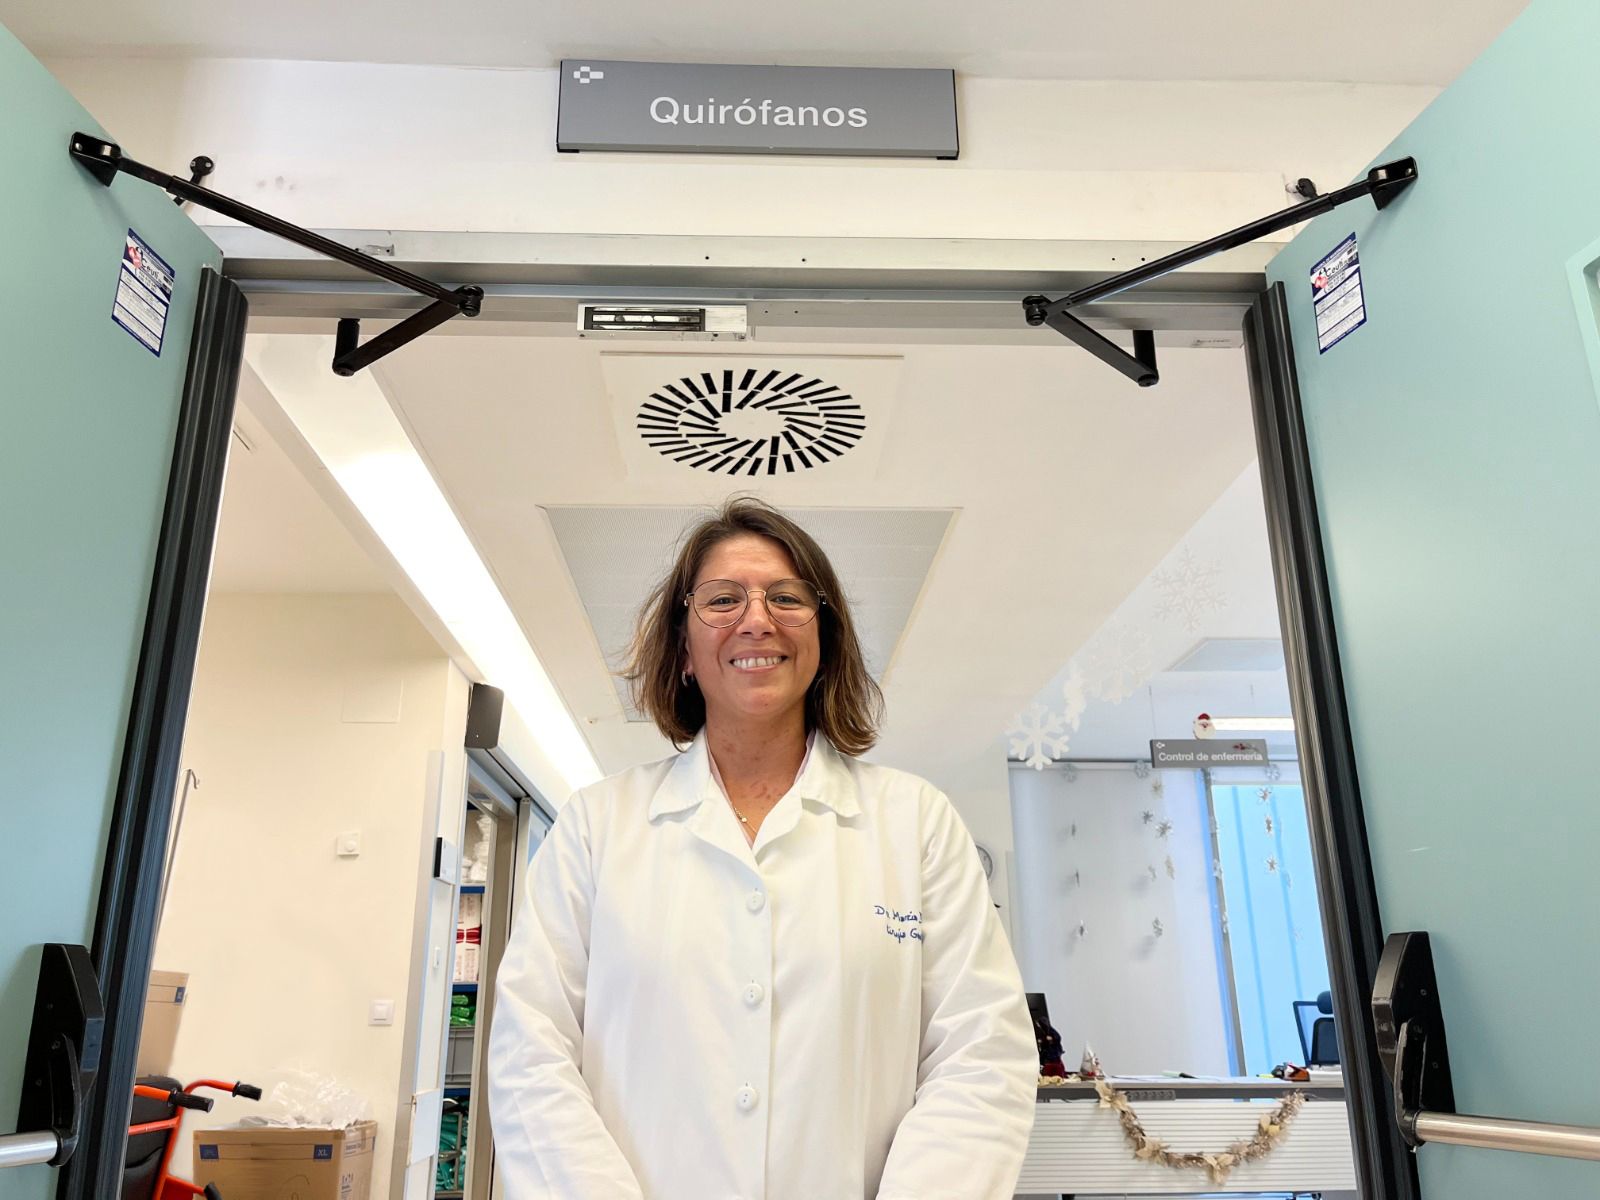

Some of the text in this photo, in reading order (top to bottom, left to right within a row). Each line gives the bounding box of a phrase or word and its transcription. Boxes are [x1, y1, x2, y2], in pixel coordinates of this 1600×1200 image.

[650, 96, 869, 128] Quirófanos
[1158, 752, 1194, 762] Control
[1196, 752, 1209, 762] de
